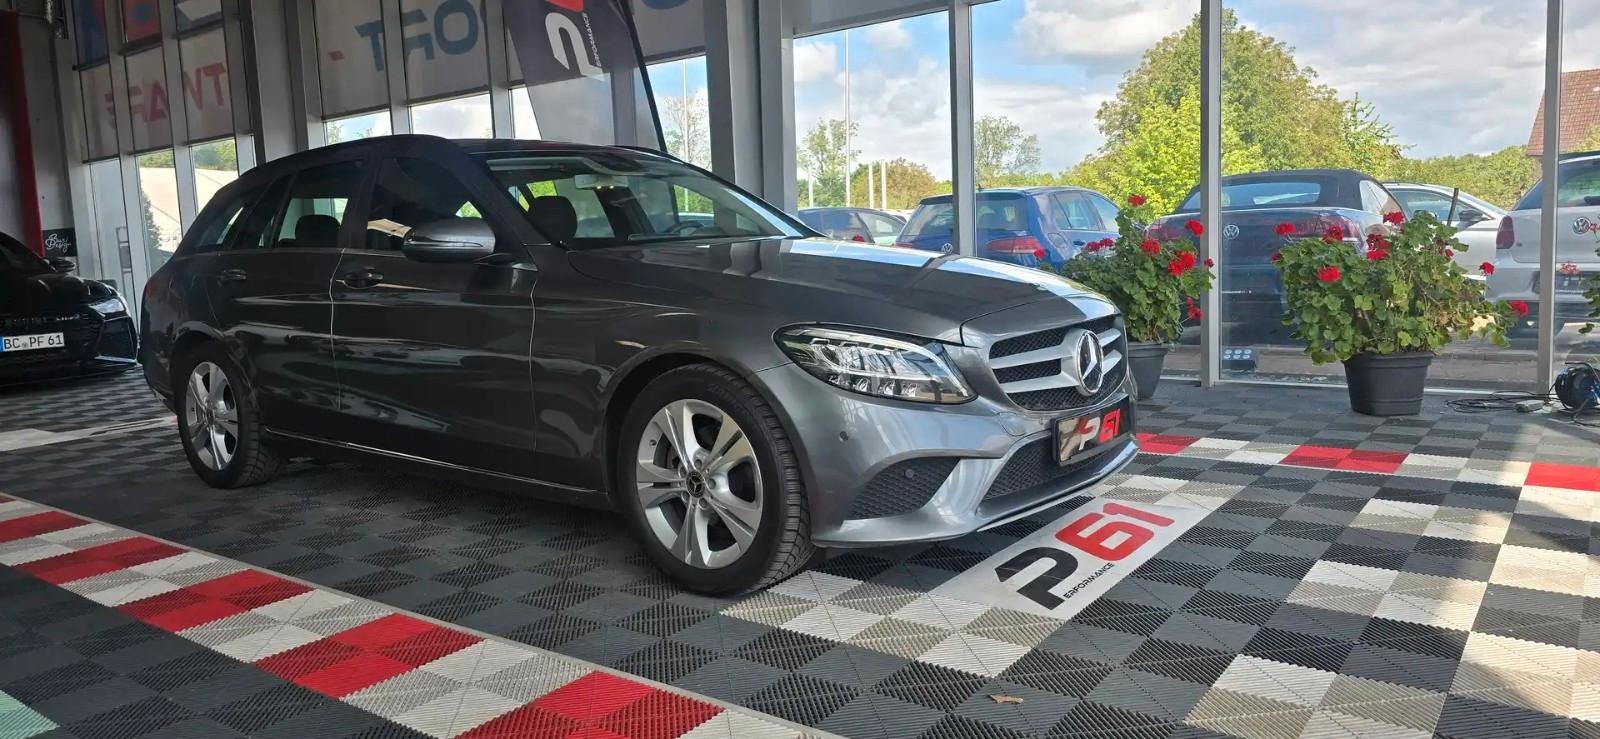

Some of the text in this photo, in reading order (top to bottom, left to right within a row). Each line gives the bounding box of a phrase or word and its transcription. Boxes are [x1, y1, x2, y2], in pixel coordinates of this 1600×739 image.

[4, 335, 63, 350] BC PF 61
[1076, 408, 1120, 451] P61
[994, 502, 1175, 610] P61
[1063, 562, 1114, 599] ERFORMANCE
